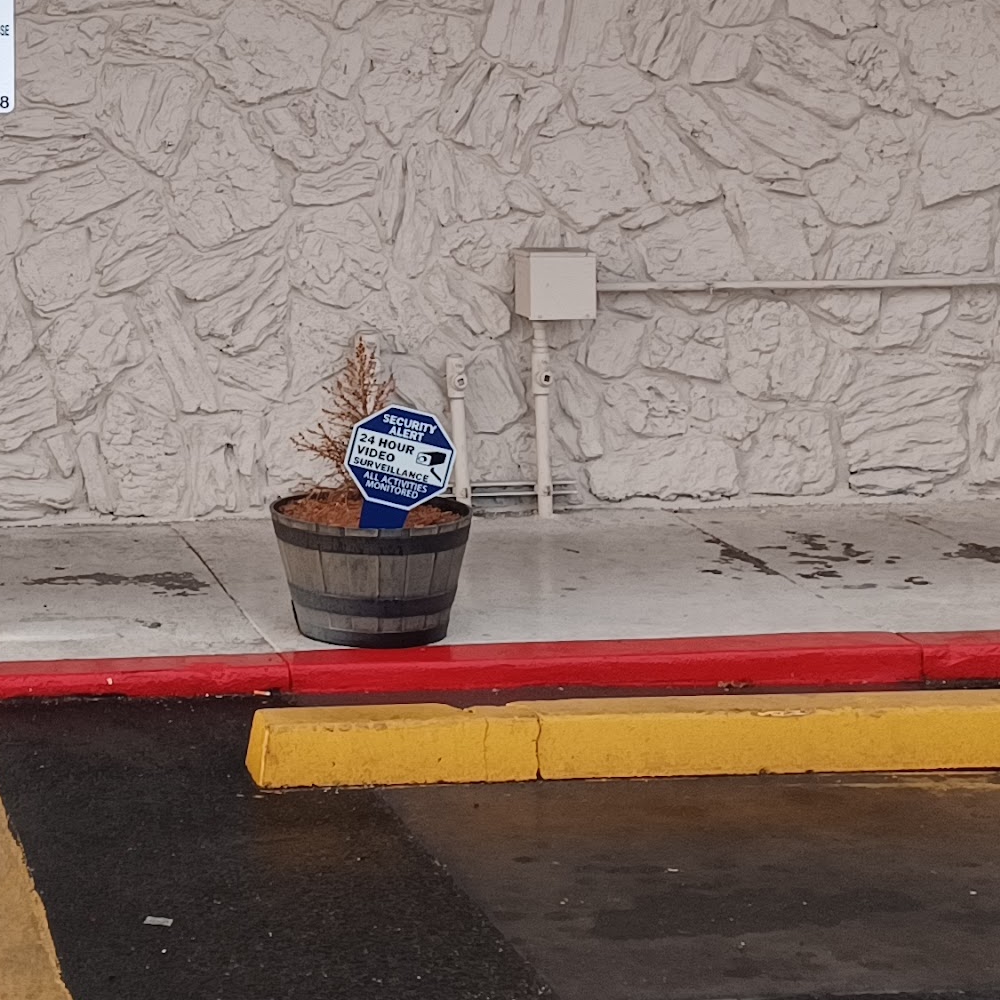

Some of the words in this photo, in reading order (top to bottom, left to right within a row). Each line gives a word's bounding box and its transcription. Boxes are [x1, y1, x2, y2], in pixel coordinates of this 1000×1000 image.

[382, 413, 437, 435] SECURITY
[388, 426, 425, 442] ALERT
[357, 445, 395, 462] VIDEO
[359, 433, 375, 445] 24
[378, 438, 415, 455] HOUR
[353, 456, 429, 483] SURVEILLANCE
[363, 471, 379, 482] ALL
[380, 475, 428, 494] ACTIVITIES
[365, 480, 419, 500] MONITORED
